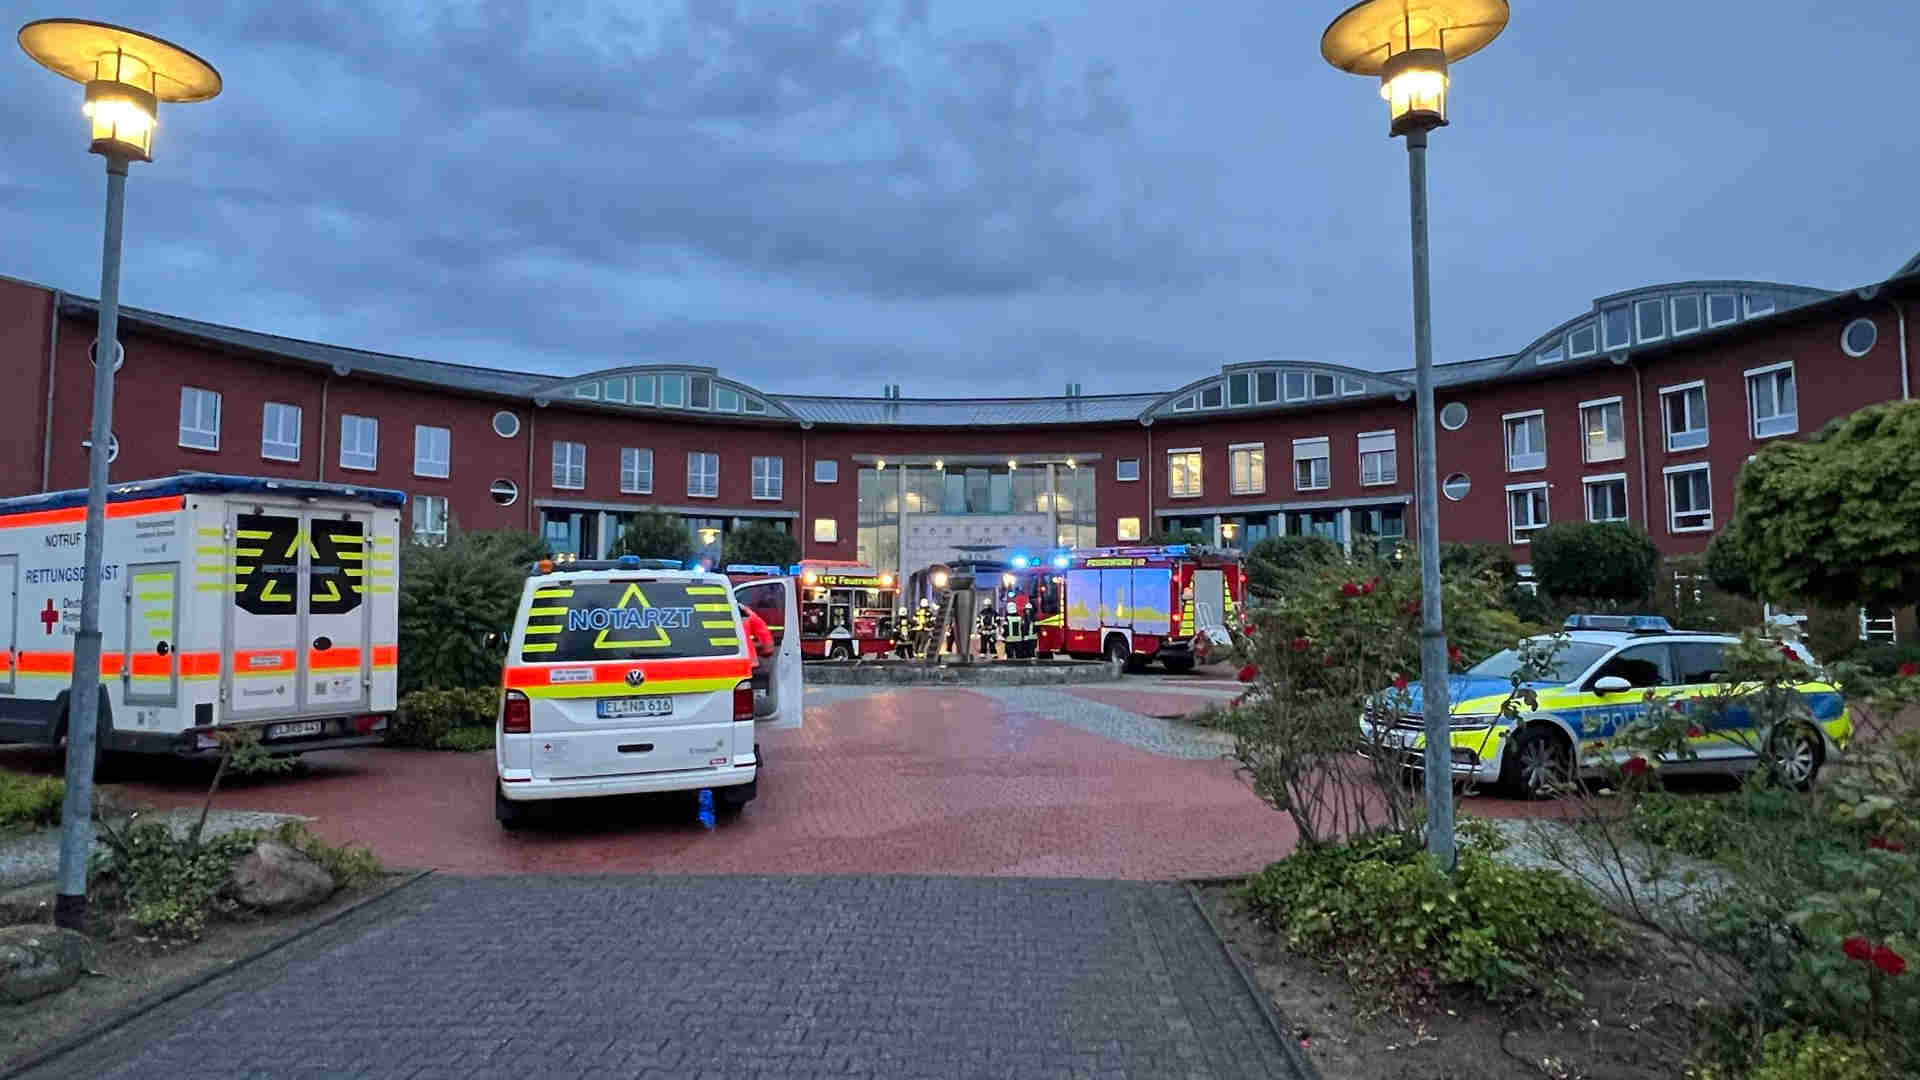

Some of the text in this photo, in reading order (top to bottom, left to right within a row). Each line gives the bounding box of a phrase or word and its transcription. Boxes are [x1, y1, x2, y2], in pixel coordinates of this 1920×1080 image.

[45, 532, 82, 548] NOTRUF
[568, 607, 694, 631] NOTARZT
[648, 700, 671, 711] 616
